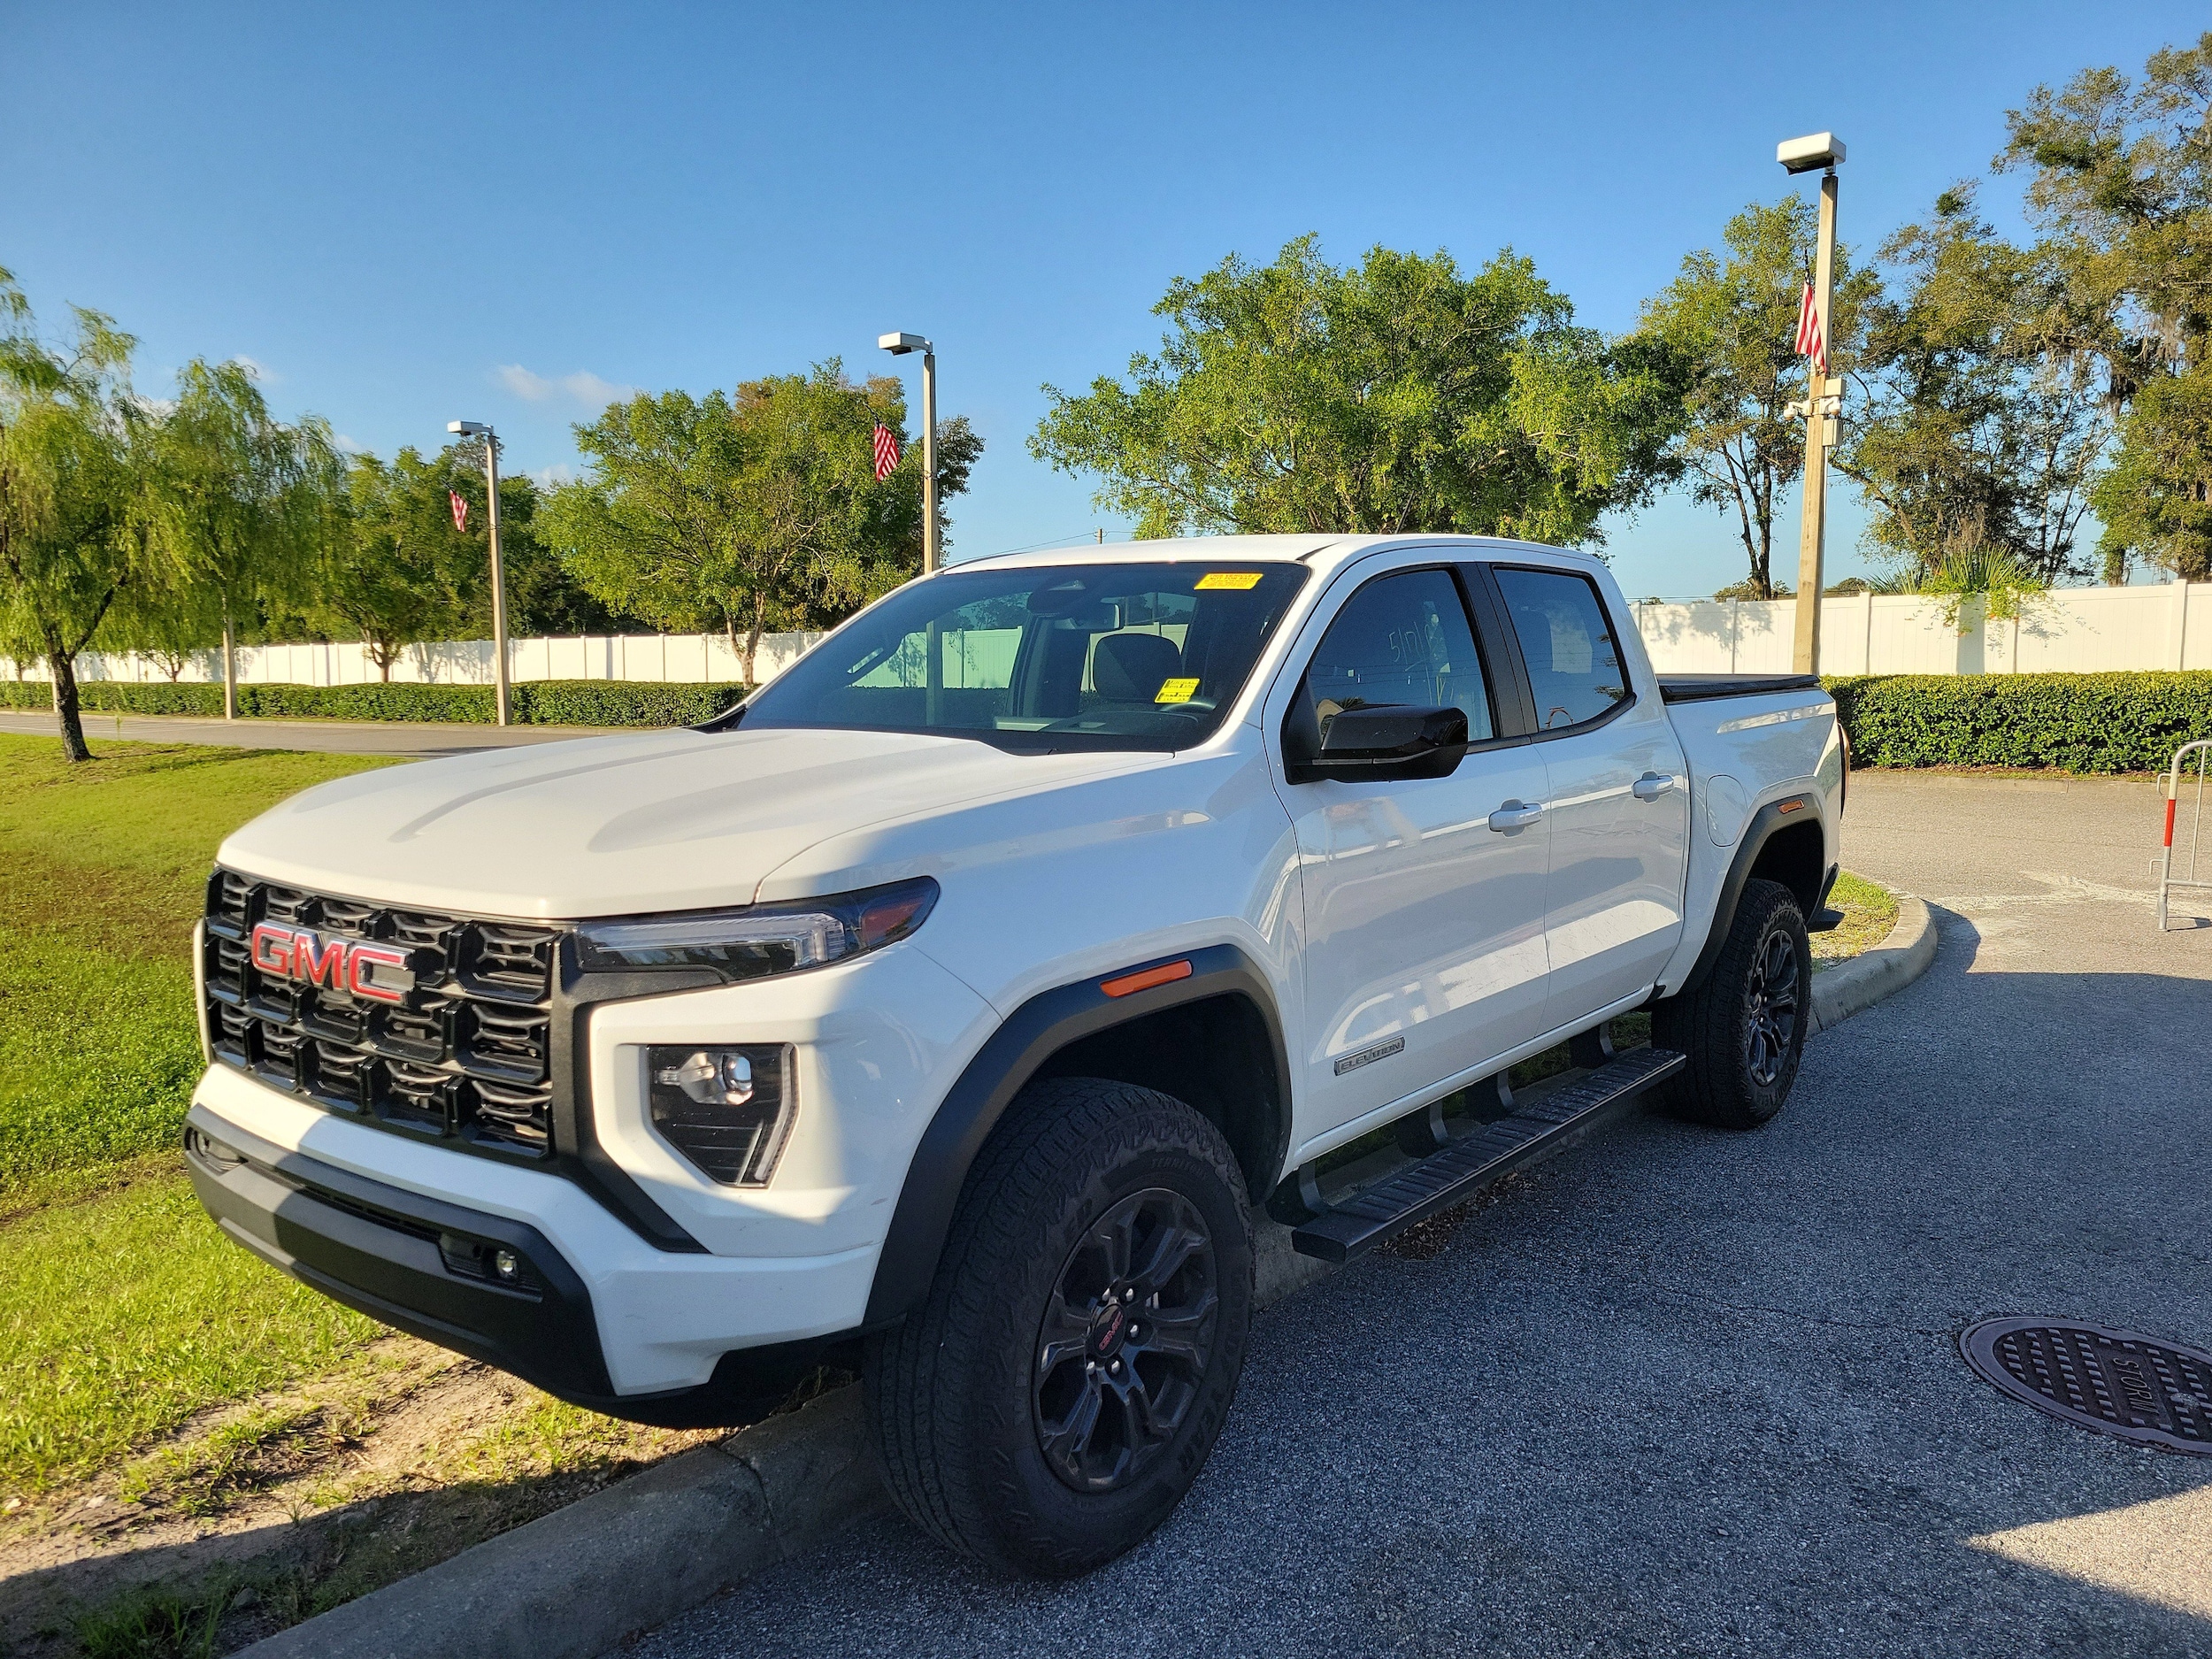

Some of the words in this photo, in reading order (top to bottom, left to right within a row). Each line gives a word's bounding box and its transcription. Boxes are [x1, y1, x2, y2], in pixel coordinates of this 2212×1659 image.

[252, 920, 415, 1006] GMC
[1340, 1041, 1401, 1070] ELEVATION
[1098, 1311, 1124, 1351] GMC
[2113, 1357, 2160, 1414] STORM
